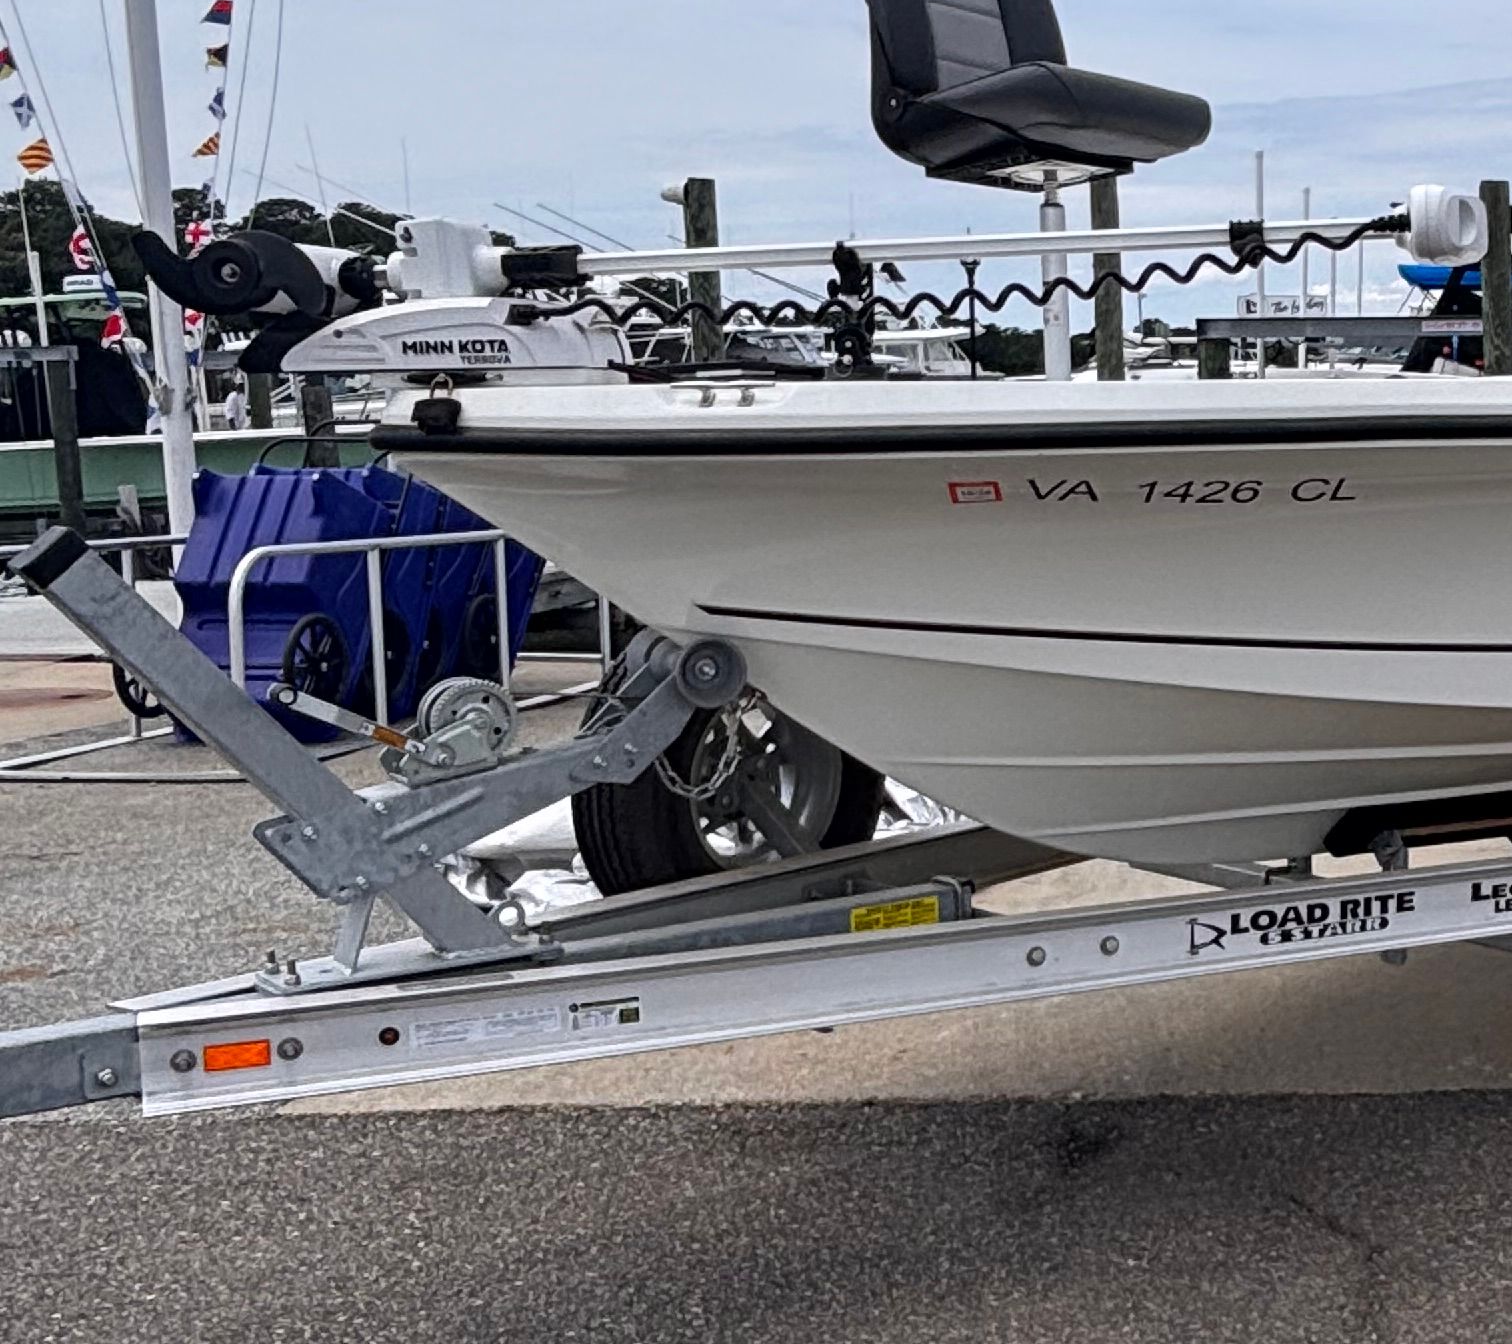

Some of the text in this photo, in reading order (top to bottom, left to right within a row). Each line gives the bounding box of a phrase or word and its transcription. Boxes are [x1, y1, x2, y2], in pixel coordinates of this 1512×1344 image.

[401, 338, 510, 355] MINN KOTA
[1027, 478, 1357, 504] VA 1426 CL
[1230, 890, 1416, 935] LOAD RITE
